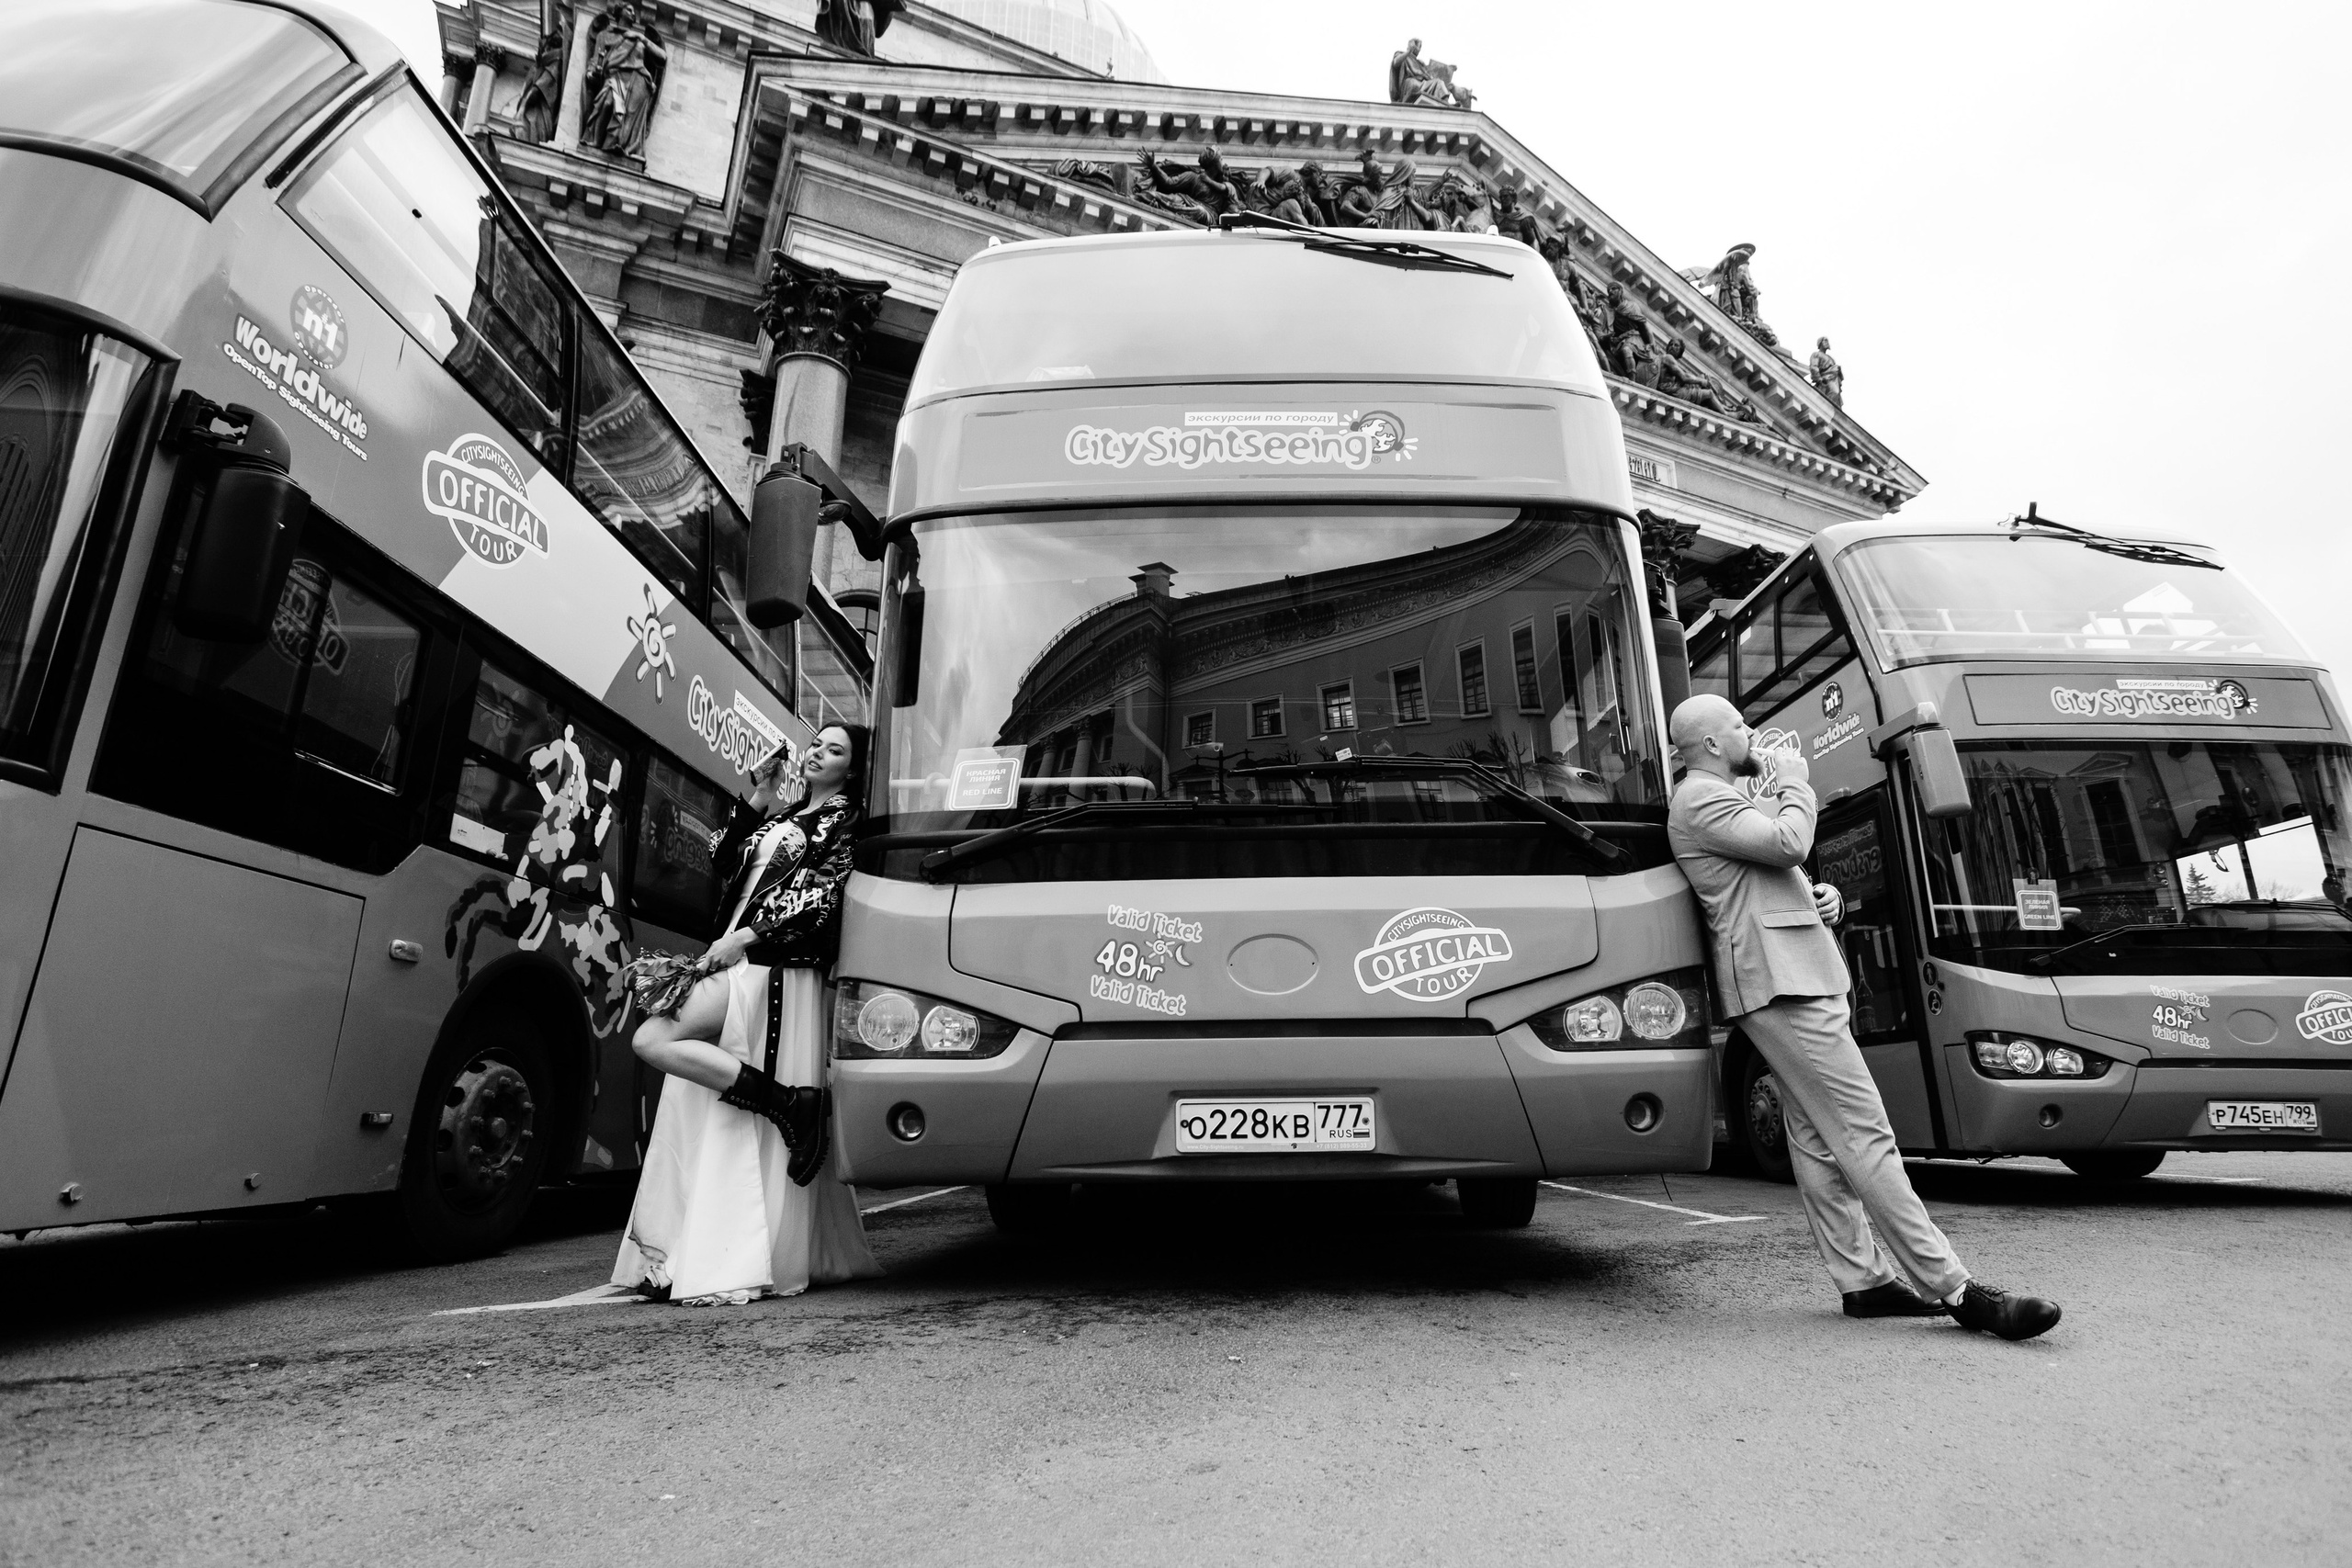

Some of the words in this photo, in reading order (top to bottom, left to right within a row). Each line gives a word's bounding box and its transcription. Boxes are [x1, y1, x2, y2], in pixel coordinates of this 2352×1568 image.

[235, 316, 368, 439] Worldwide
[277, 385, 340, 440] Sightseeing
[341, 433, 368, 461] Tours
[1187, 414, 1261, 423] экскурсии
[1285, 415, 1334, 423] городу
[439, 469, 543, 549] OFFICIAL
[469, 524, 517, 561] TOUR
[1813, 713, 1860, 750] Worldwide
[966, 768, 1006, 776] КРАСНАЯ
[968, 774, 1001, 783] ЛИНИЯ
[1107, 904, 1151, 931] Valid
[1152, 912, 1203, 942] Ticket
[1387, 913, 1465, 942] CITYSIGHTSEEING
[1096, 941, 1163, 982] 48hr
[1373, 934, 1502, 981] OFFICIAL
[1416, 967, 1473, 994] TOUR
[1091, 974, 1135, 1004] Valid
[1136, 984, 1186, 1016] Ticket
[2150, 984, 2178, 1001] Valid
[2178, 989, 2211, 1008] Ticket
[2153, 1005, 2192, 1029] 48hr
[2152, 1024, 2178, 1042] Valid
[2179, 1031, 2210, 1049] Ticket
[1317, 1104, 1363, 1129] 777
[2286, 1105, 2311, 1120] 799
[1329, 1130, 1352, 1139] RUS
